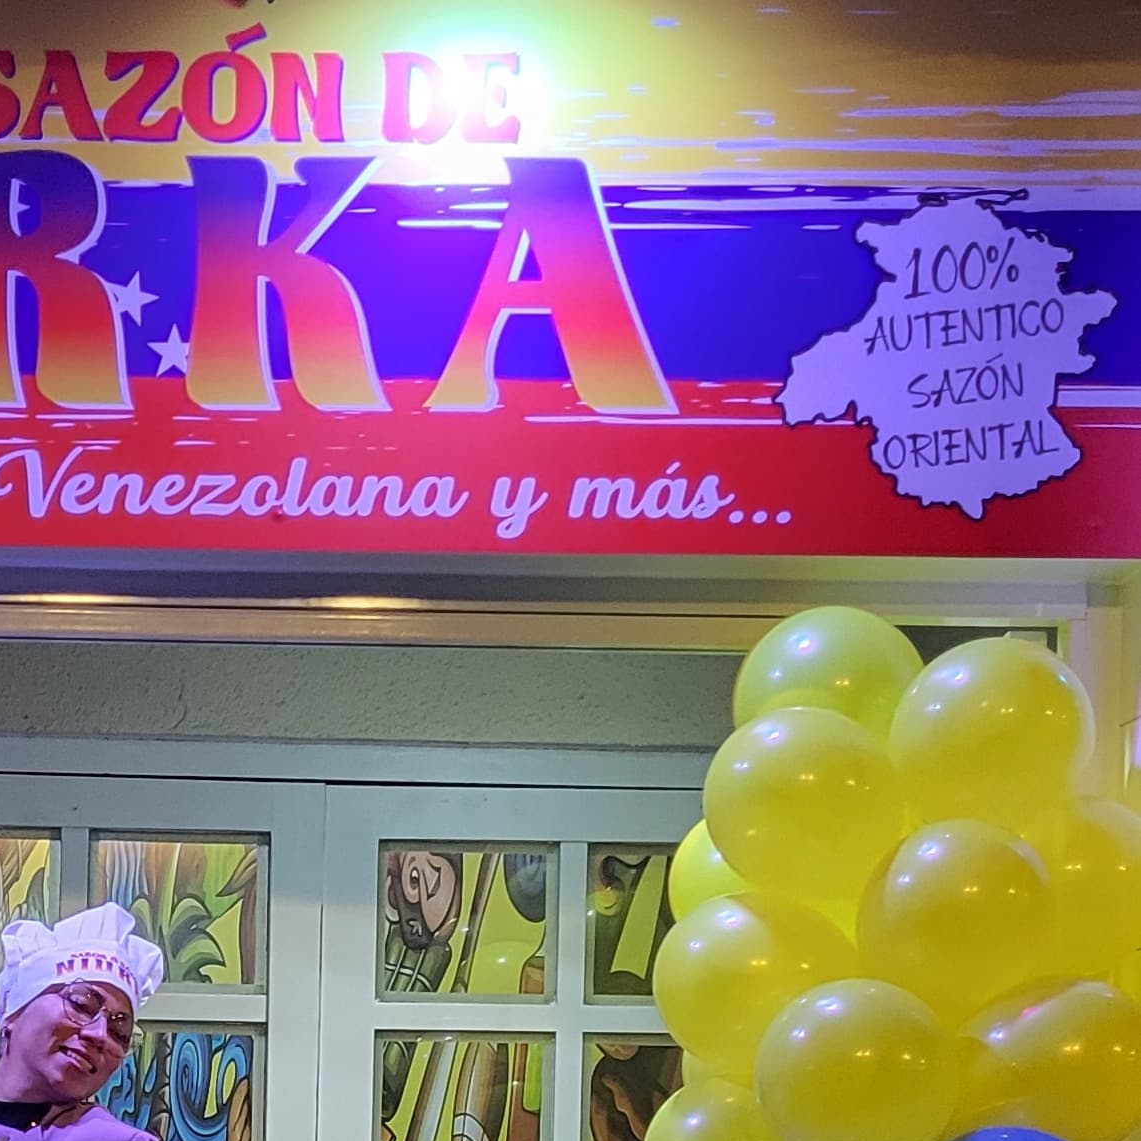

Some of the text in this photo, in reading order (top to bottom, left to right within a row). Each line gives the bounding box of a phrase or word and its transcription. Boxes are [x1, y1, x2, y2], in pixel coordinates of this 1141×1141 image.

[382, 50, 523, 145] DE
[904, 236, 1019, 300] 100%
[863, 298, 1064, 356] AUTENTICO
[906, 352, 1025, 409] SAZÓN
[882, 419, 1060, 470] ORIENTAL
[489, 476, 549, 539] y
